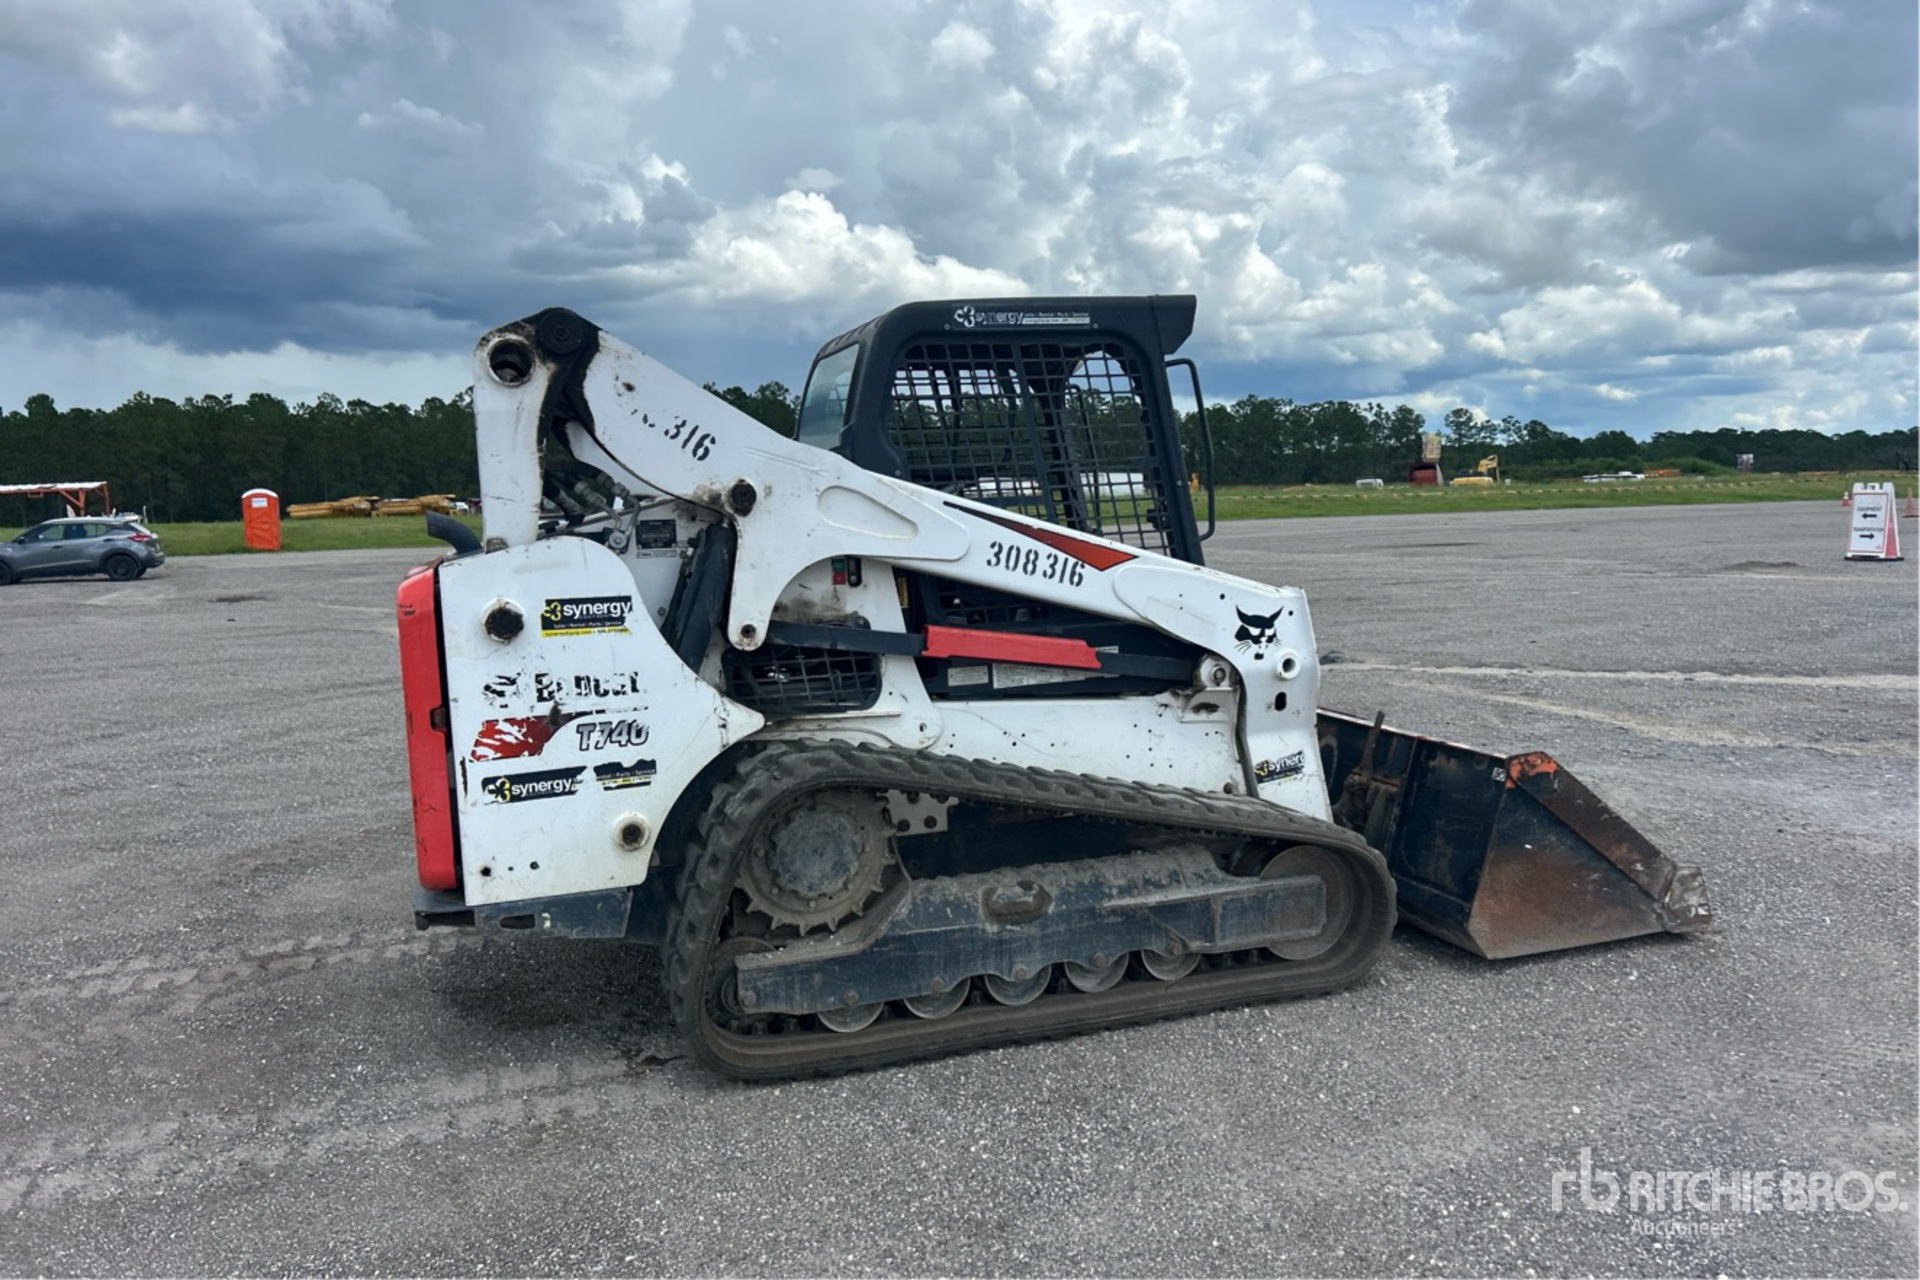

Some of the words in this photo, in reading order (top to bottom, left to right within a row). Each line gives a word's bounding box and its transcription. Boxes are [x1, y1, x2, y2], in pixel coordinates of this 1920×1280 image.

[976, 311, 1024, 325] synergy
[986, 541, 1085, 587] 308316
[563, 601, 631, 619] synergy
[576, 719, 650, 751] T740
[511, 779, 572, 797] synergy
